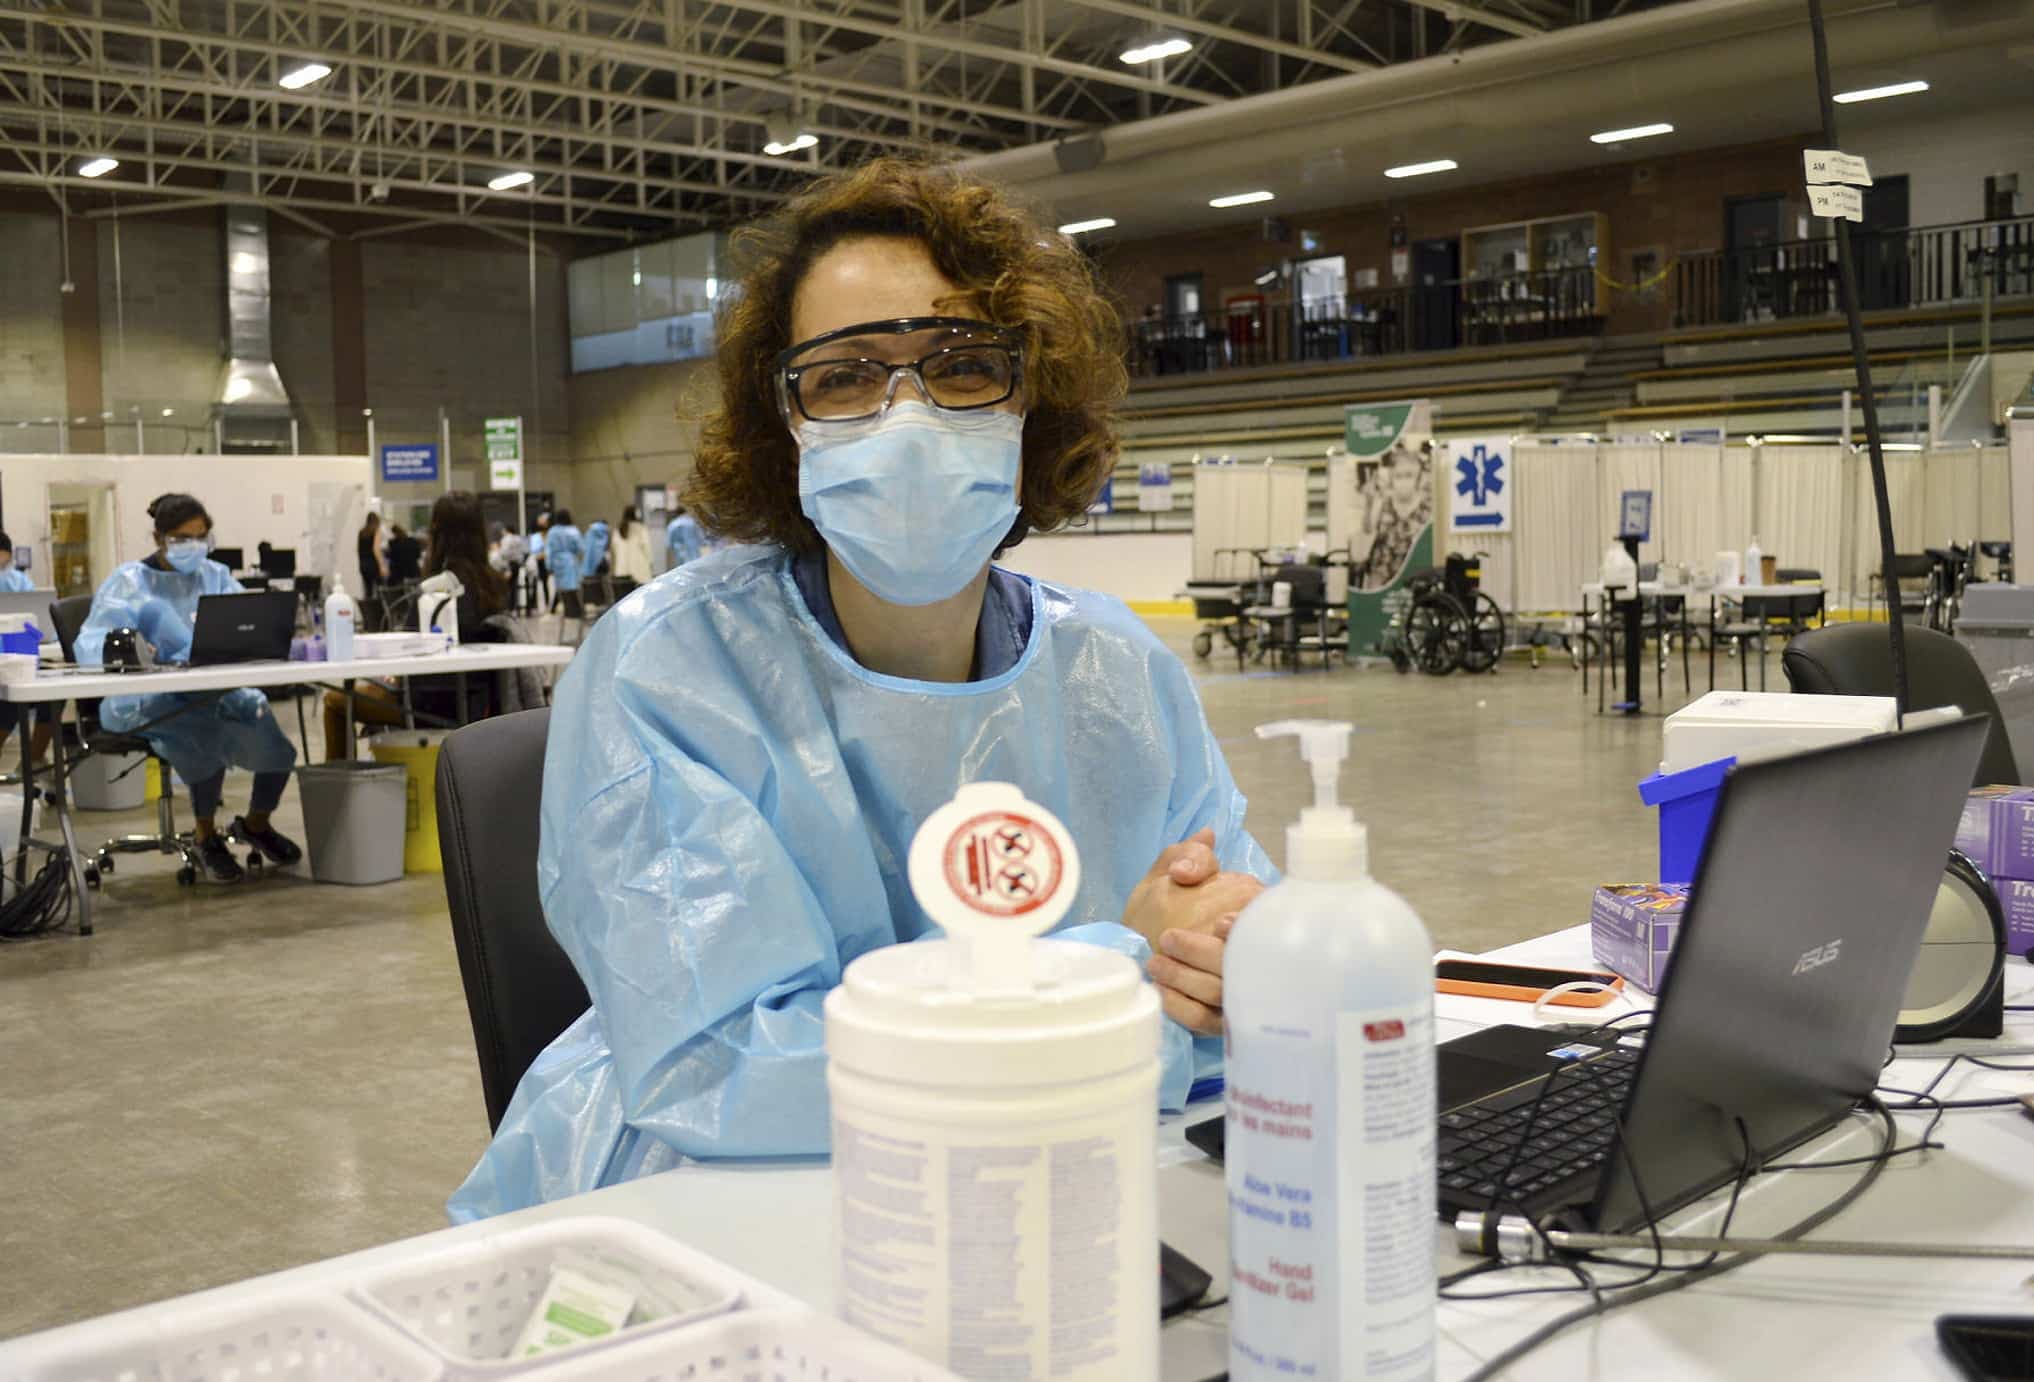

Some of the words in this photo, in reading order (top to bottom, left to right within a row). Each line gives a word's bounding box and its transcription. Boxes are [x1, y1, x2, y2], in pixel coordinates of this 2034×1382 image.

[1792, 938, 1842, 975] ASUS
[1275, 1183, 1312, 1204] Vera
[1267, 1254, 1313, 1280] Hand
[1284, 1279, 1314, 1303] Gel
